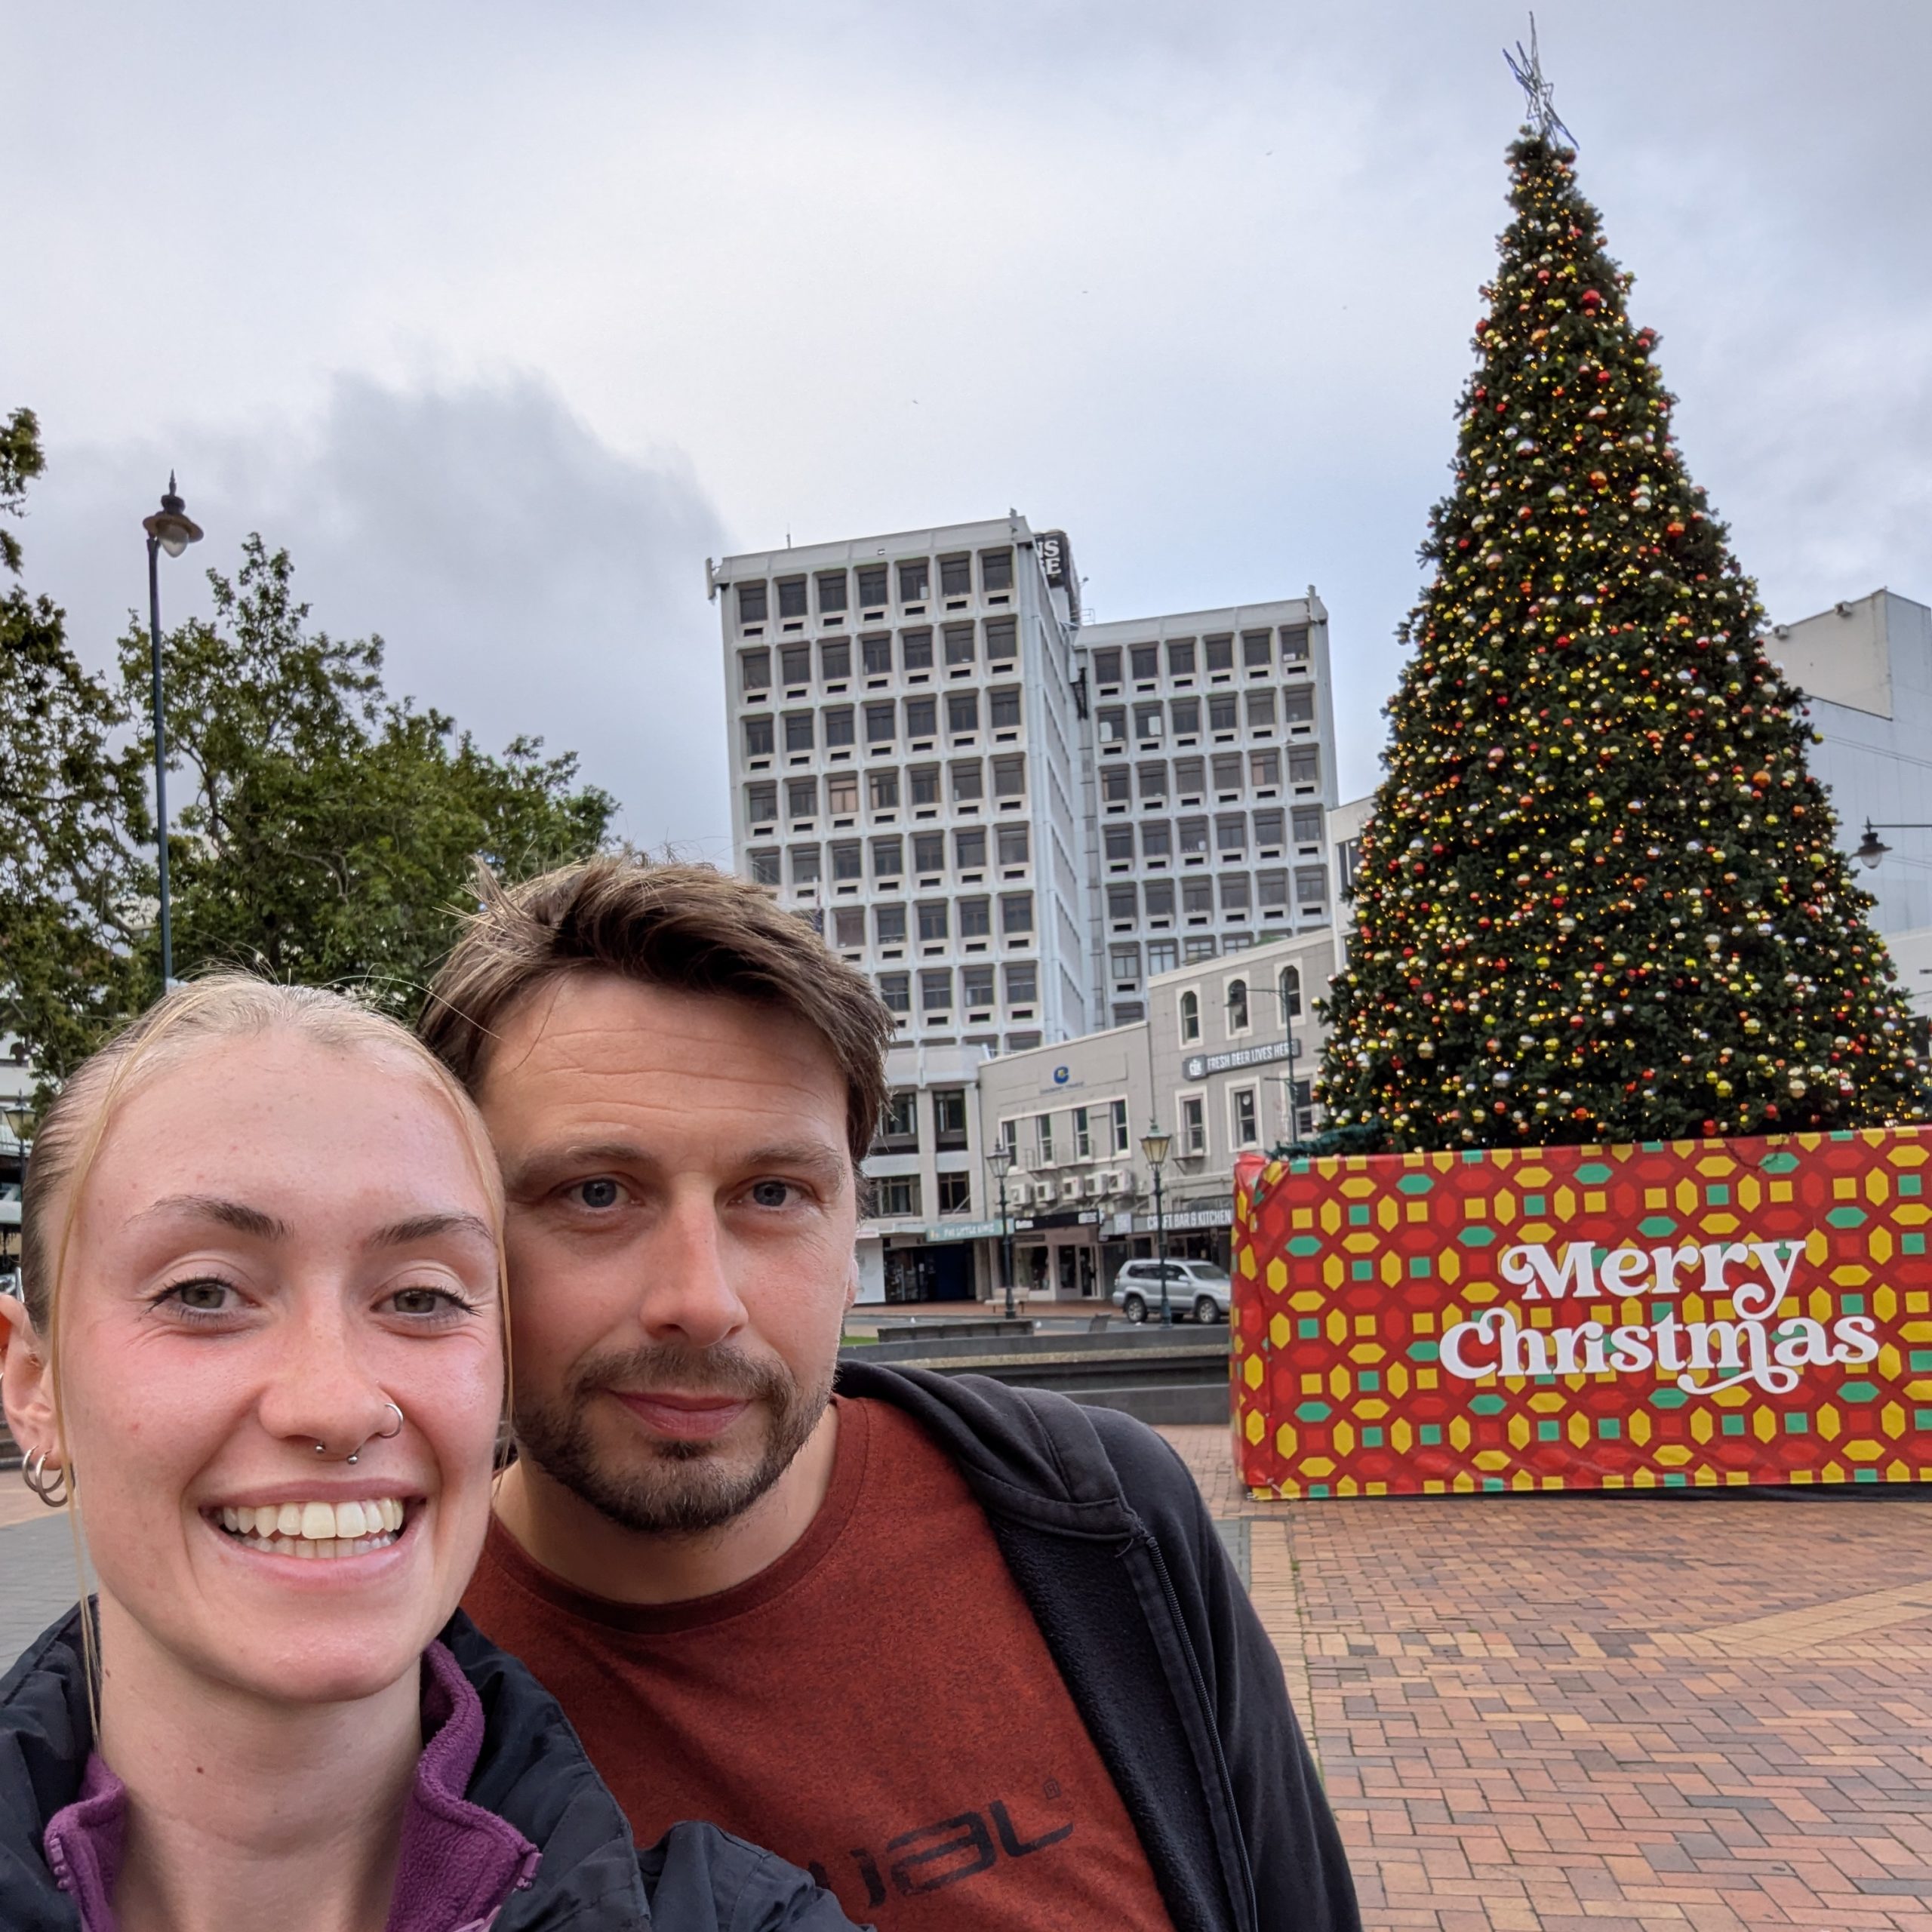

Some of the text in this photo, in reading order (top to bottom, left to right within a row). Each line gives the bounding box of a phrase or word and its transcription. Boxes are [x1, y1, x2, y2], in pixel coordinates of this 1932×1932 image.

[1208, 1054, 1230, 1070] FRESH
[1251, 1045, 1272, 1063] LIVES
[1147, 1214, 1173, 1230] CRFT
[1174, 1212, 1190, 1228] BAR
[1198, 1208, 1232, 1226] KITCHEN
[1501, 1240, 1807, 1321] Merry
[1438, 1306, 1880, 1395] Christmas
